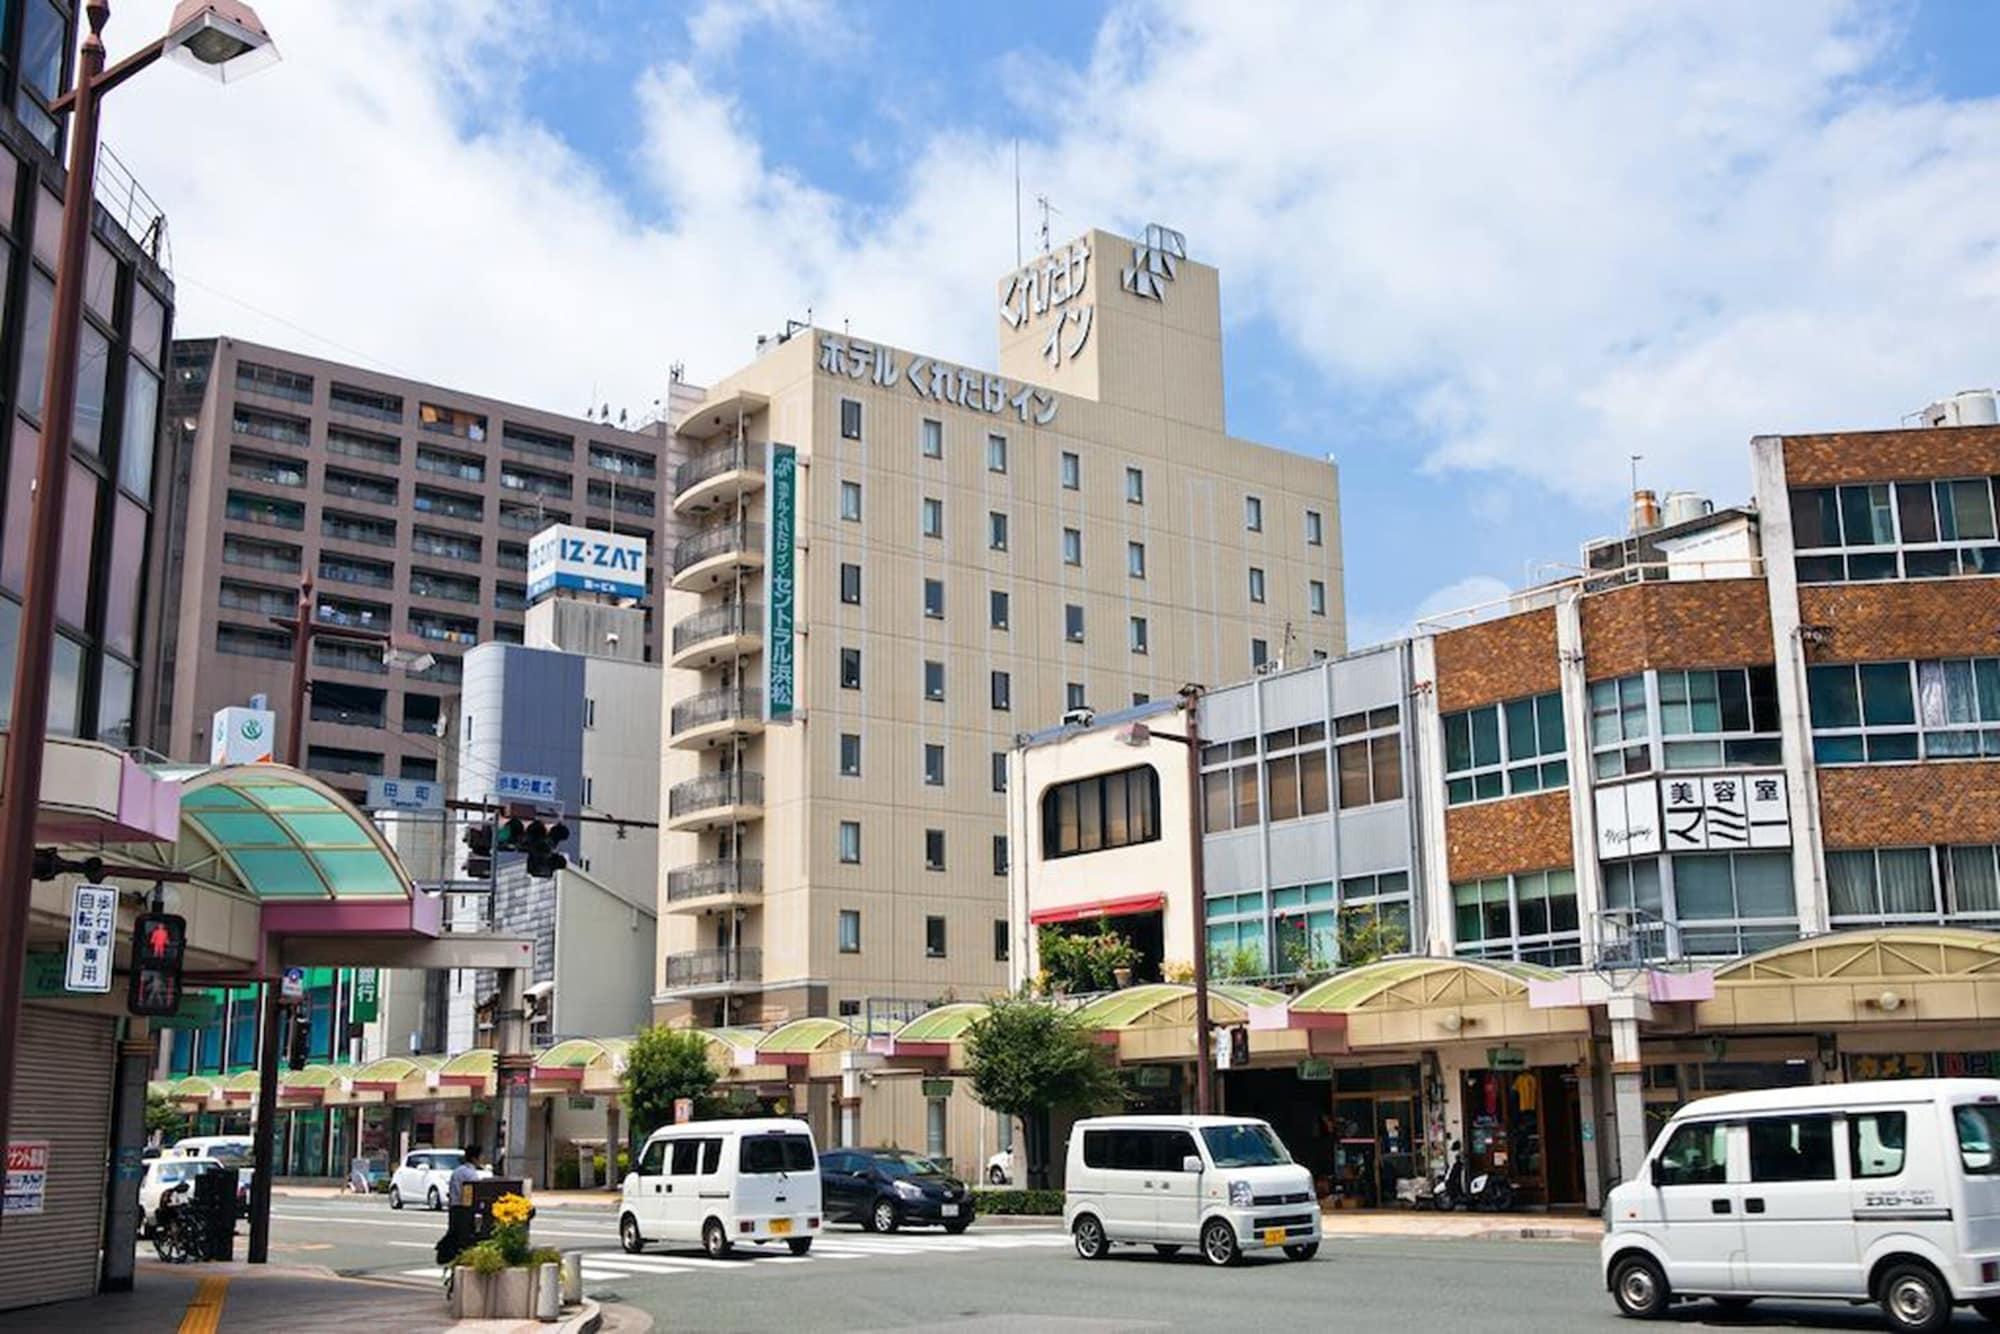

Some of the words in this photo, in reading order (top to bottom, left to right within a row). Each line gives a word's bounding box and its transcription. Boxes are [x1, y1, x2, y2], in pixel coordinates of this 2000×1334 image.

[1000, 237, 1092, 329] くれたけ
[1043, 304, 1094, 369] イン
[820, 336, 898, 387] ホテル
[907, 356, 1058, 425] くれたけイン
[1671, 779, 1780, 804] 美容室
[1666, 806, 1788, 844] マミー
[76, 893, 95, 945] 自転車
[95, 894, 111, 947] 歩行者
[80, 948, 98, 983] 専用
